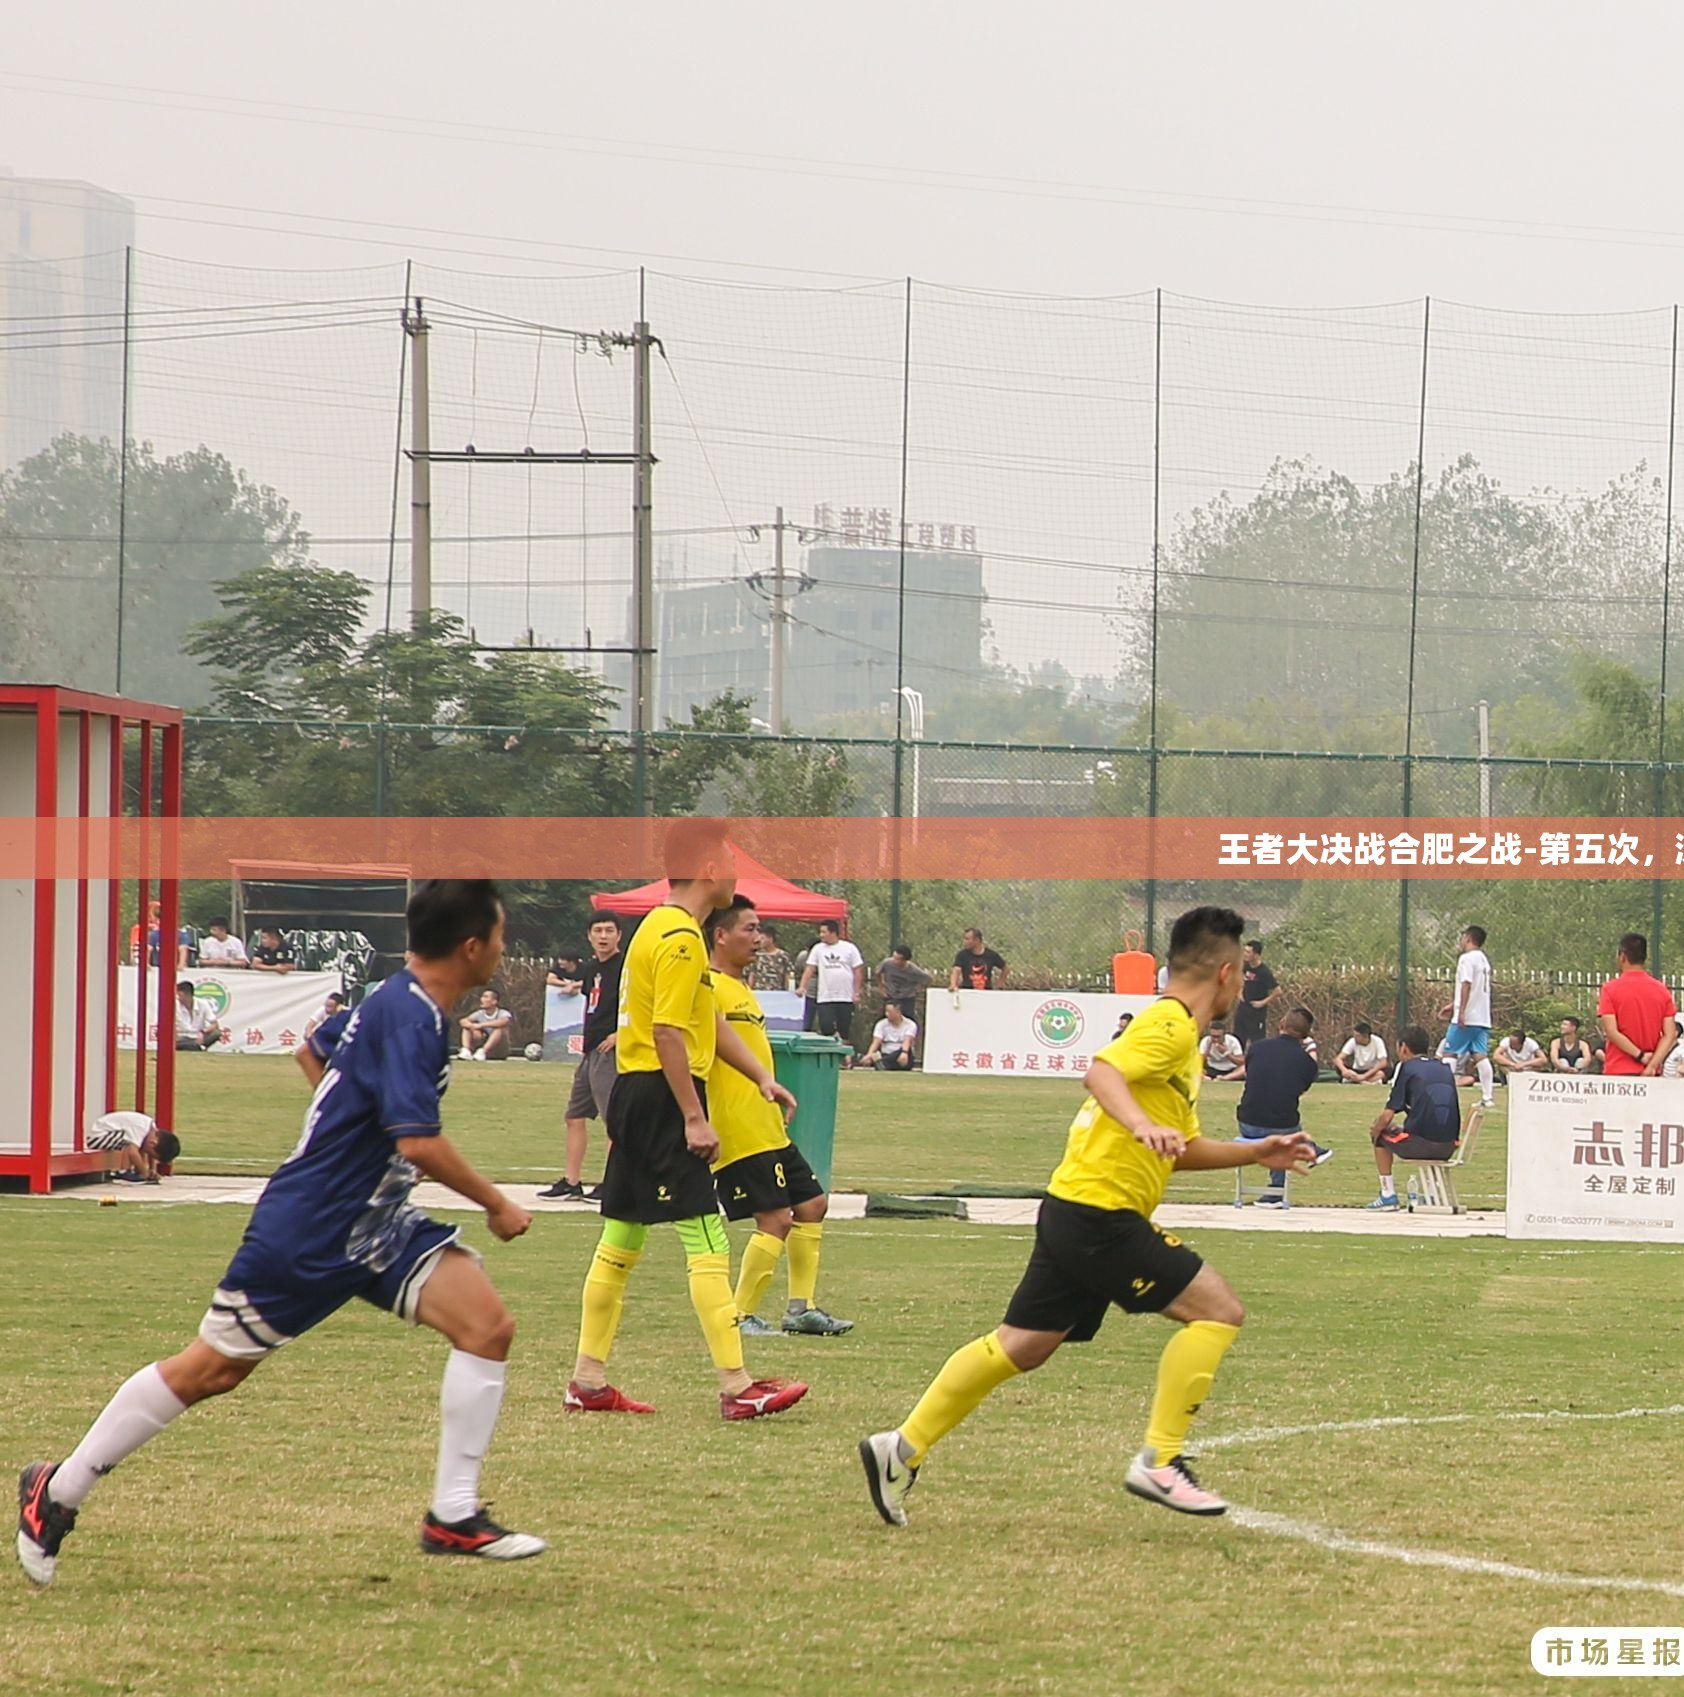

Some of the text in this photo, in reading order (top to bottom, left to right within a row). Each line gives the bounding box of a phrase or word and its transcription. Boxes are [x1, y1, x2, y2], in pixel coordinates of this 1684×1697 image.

[1528, 1079, 1647, 1097] ZBOM 志邦家居
[775, 1162, 787, 1188] 8
[1584, 1174, 1676, 1196] 全屋定制
